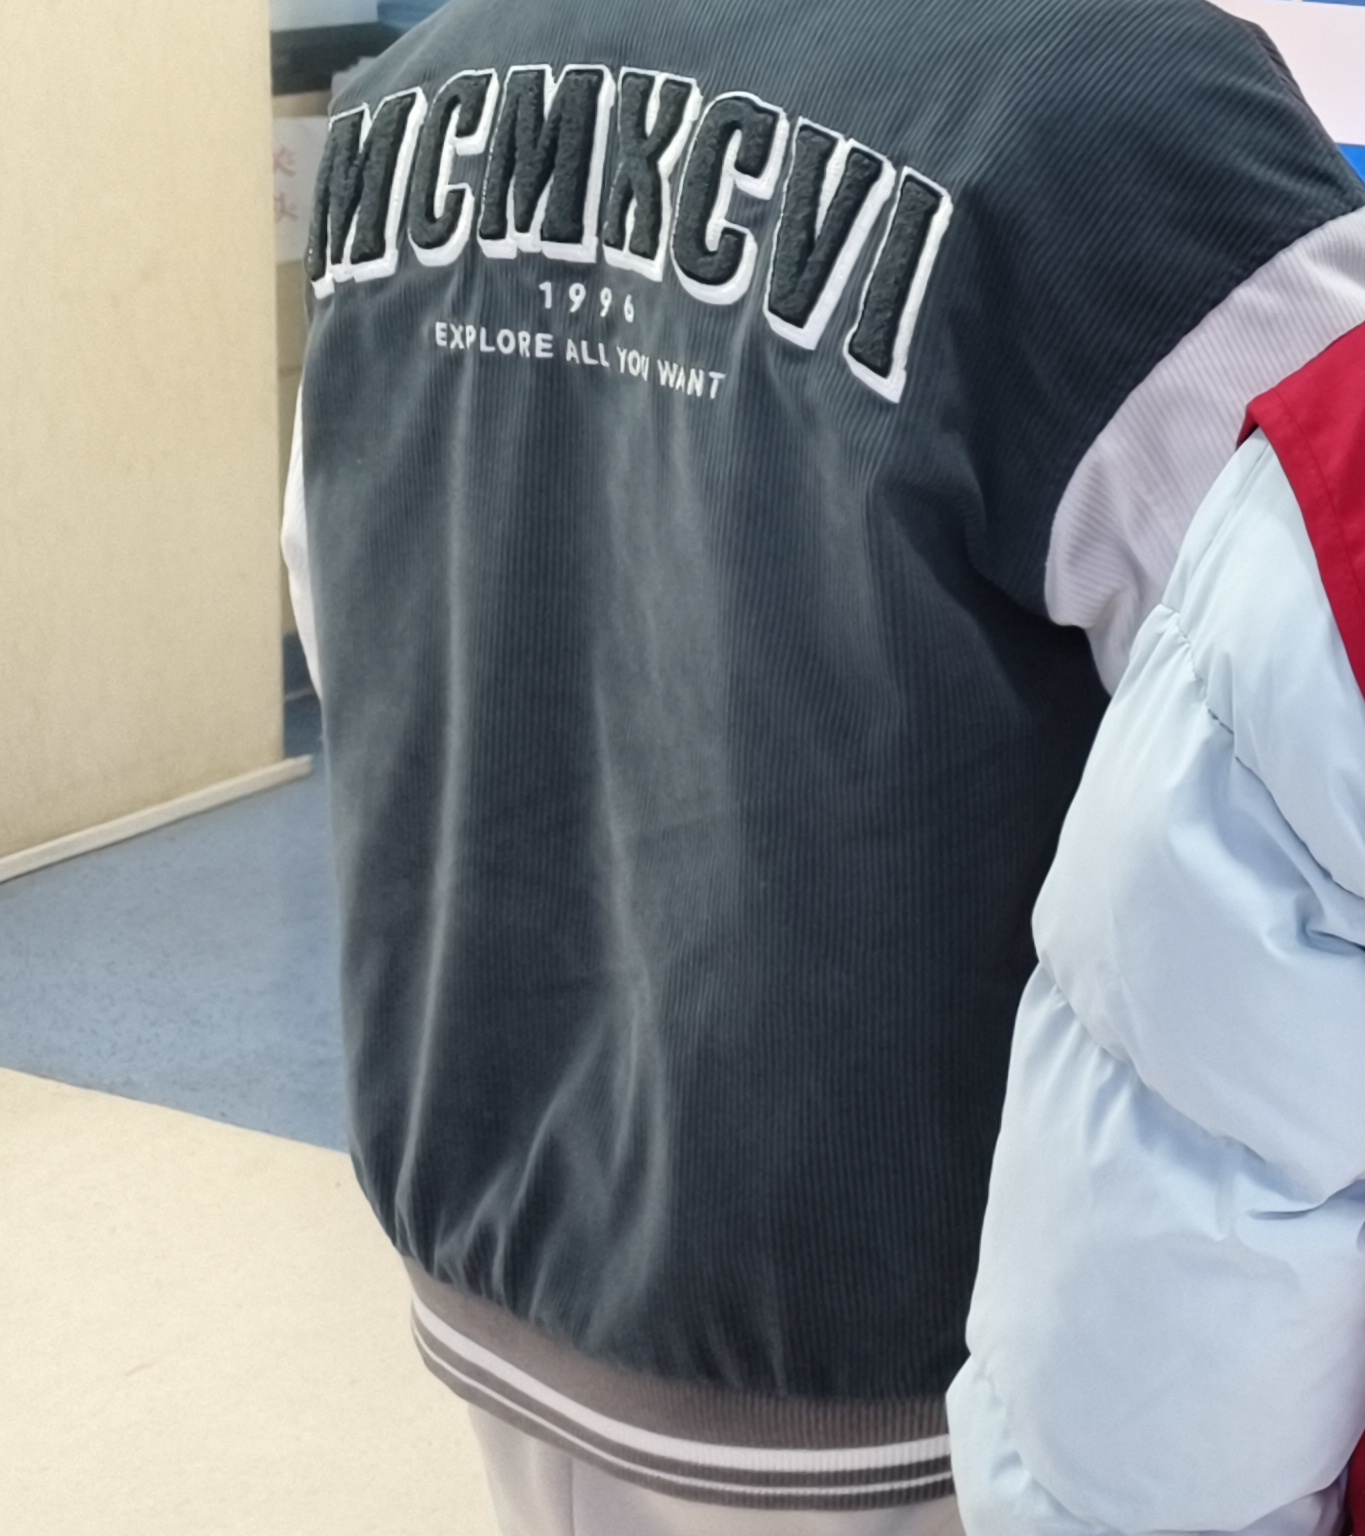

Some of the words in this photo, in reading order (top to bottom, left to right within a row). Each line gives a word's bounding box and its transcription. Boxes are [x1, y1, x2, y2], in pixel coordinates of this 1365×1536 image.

[308, 63, 953, 403] MCMXCVI
[539, 281, 635, 323] 1996
[434, 321, 554, 359] EXPLORE
[565, 338, 611, 368] ALL
[616, 345, 650, 382] YOU
[656, 359, 727, 400] WANT
